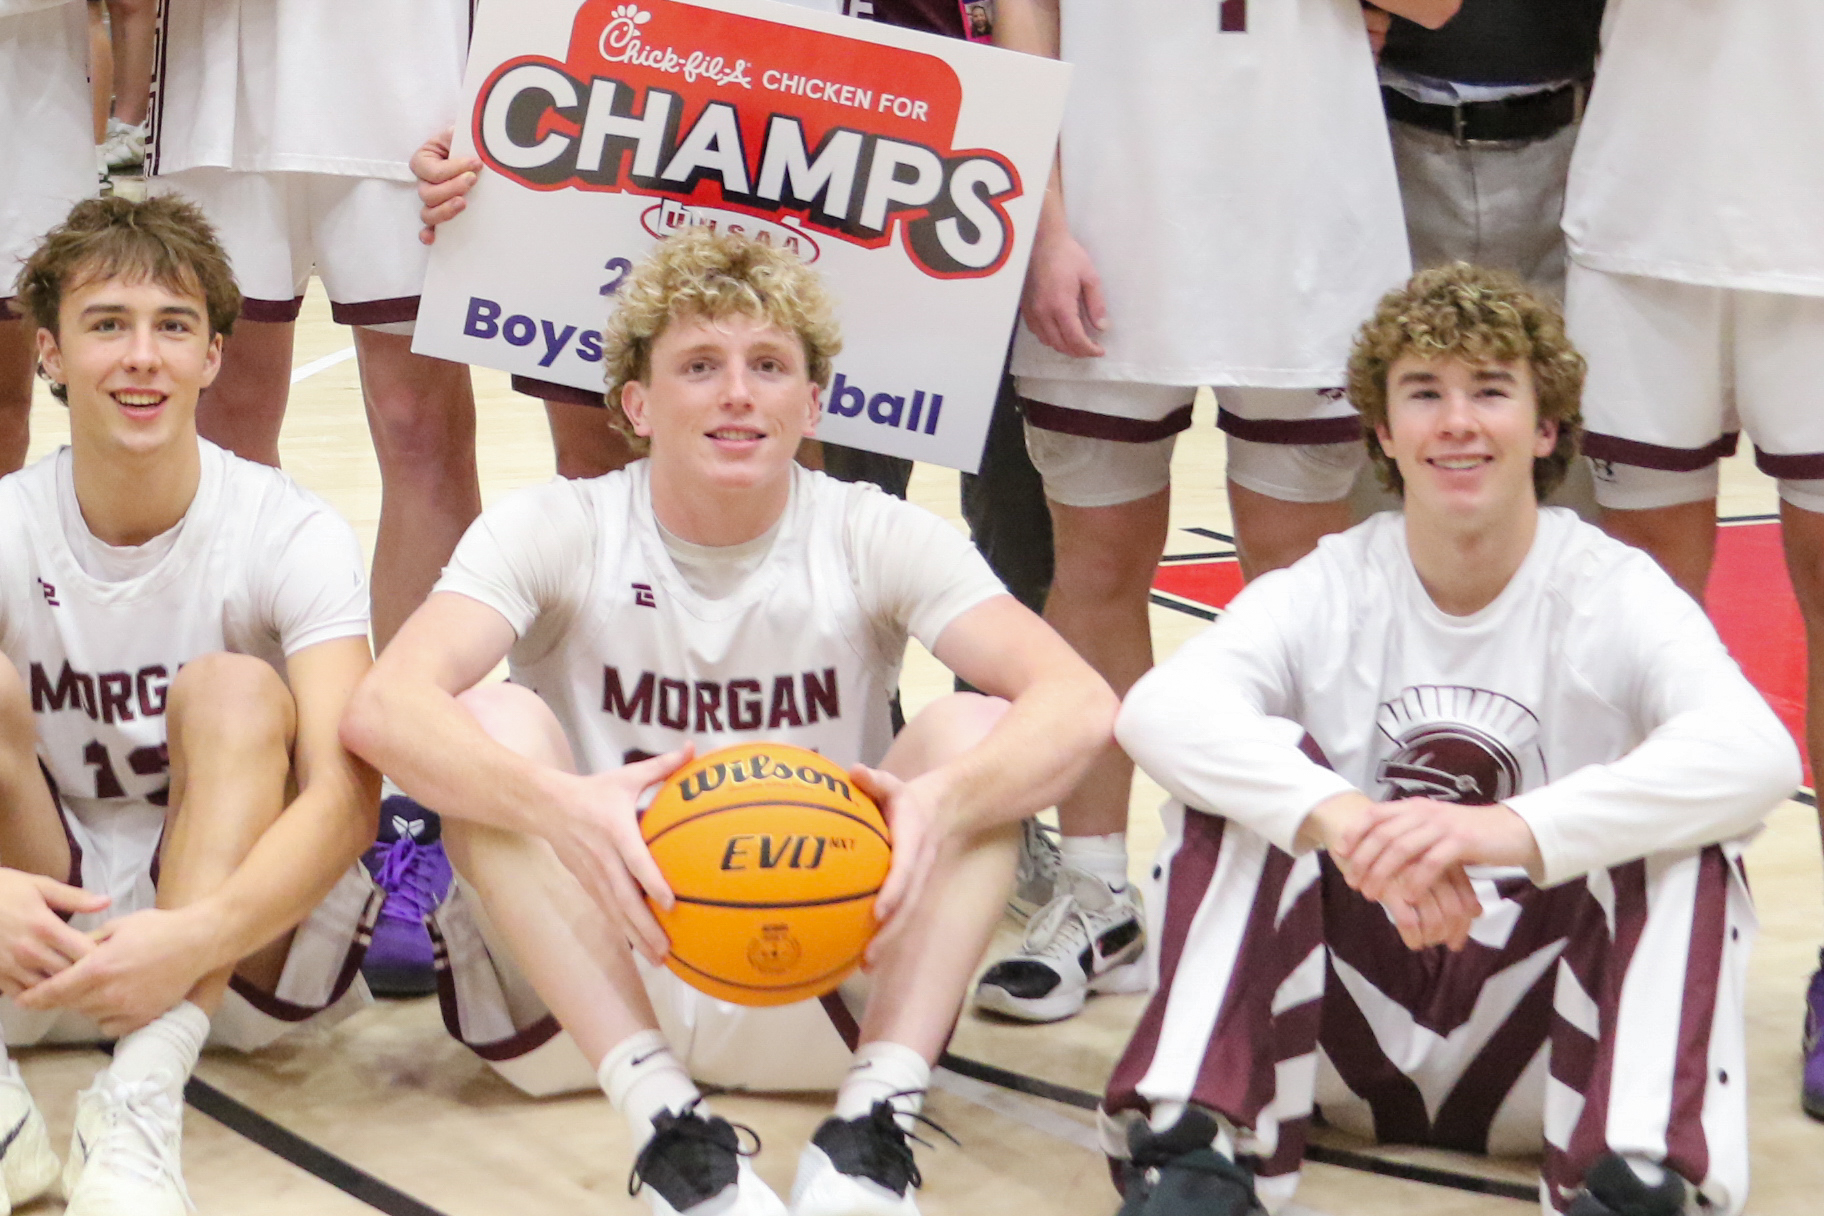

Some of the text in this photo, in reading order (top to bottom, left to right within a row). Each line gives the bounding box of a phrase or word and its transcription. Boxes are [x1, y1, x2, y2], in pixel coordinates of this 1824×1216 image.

[762, 69, 873, 111] CHICKEN
[877, 92, 930, 123] FOR
[479, 60, 1018, 272] CHAMPS
[463, 295, 604, 368] Boys
[30, 658, 185, 725] MORG
[602, 664, 841, 733] MORGAN
[676, 753, 854, 804] Wilson
[719, 833, 827, 872] EVO
